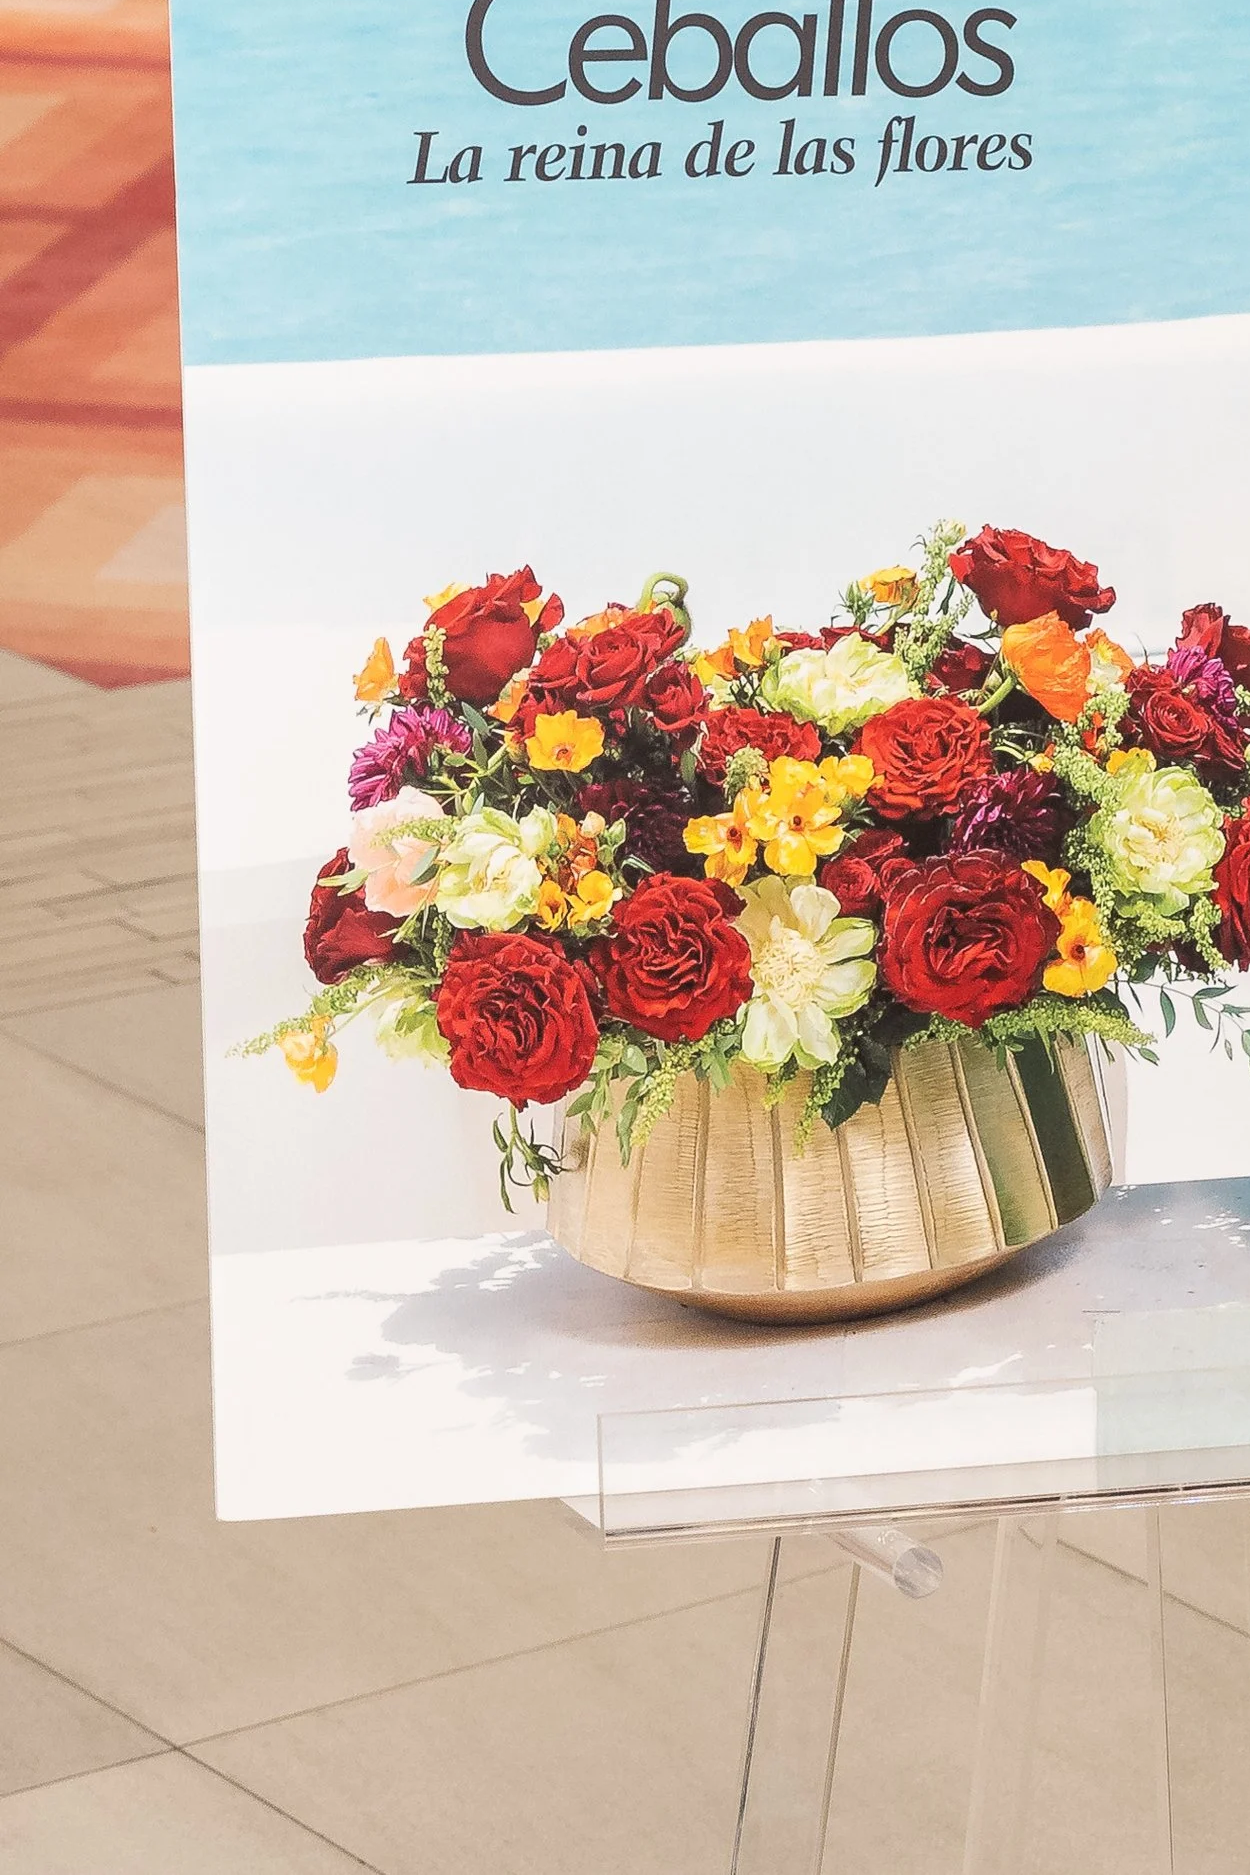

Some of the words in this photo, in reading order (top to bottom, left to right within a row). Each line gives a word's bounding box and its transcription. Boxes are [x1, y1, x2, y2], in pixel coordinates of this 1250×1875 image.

[406, 131, 483, 185] La
[503, 124, 663, 183] reina
[684, 119, 756, 178] de
[772, 117, 856, 176] las
[874, 115, 1034, 188] flores
